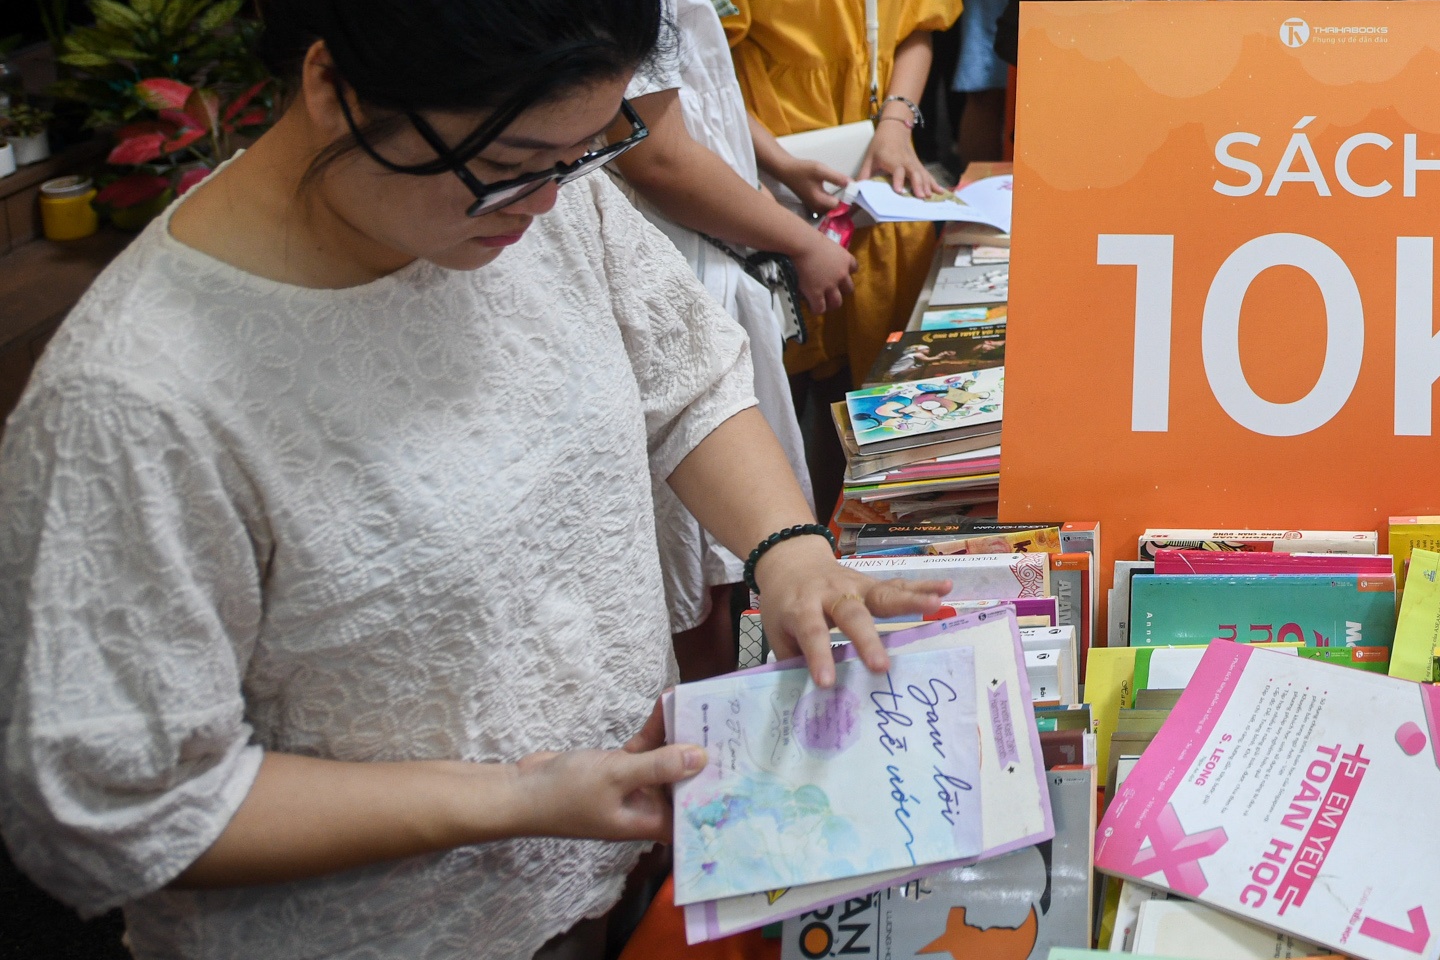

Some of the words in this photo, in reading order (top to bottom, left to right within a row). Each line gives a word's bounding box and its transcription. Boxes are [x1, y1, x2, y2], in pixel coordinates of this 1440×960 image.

[1058, 580, 1072, 624] ALAN
[1218, 733, 1232, 745] S.
[1195, 749, 1224, 786] LEONG
[1280, 743, 1341, 831] TOÁN
[1319, 792, 1348, 829] EM
[1239, 839, 1294, 908] HỌC
[1293, 836, 1331, 879] YÊU
